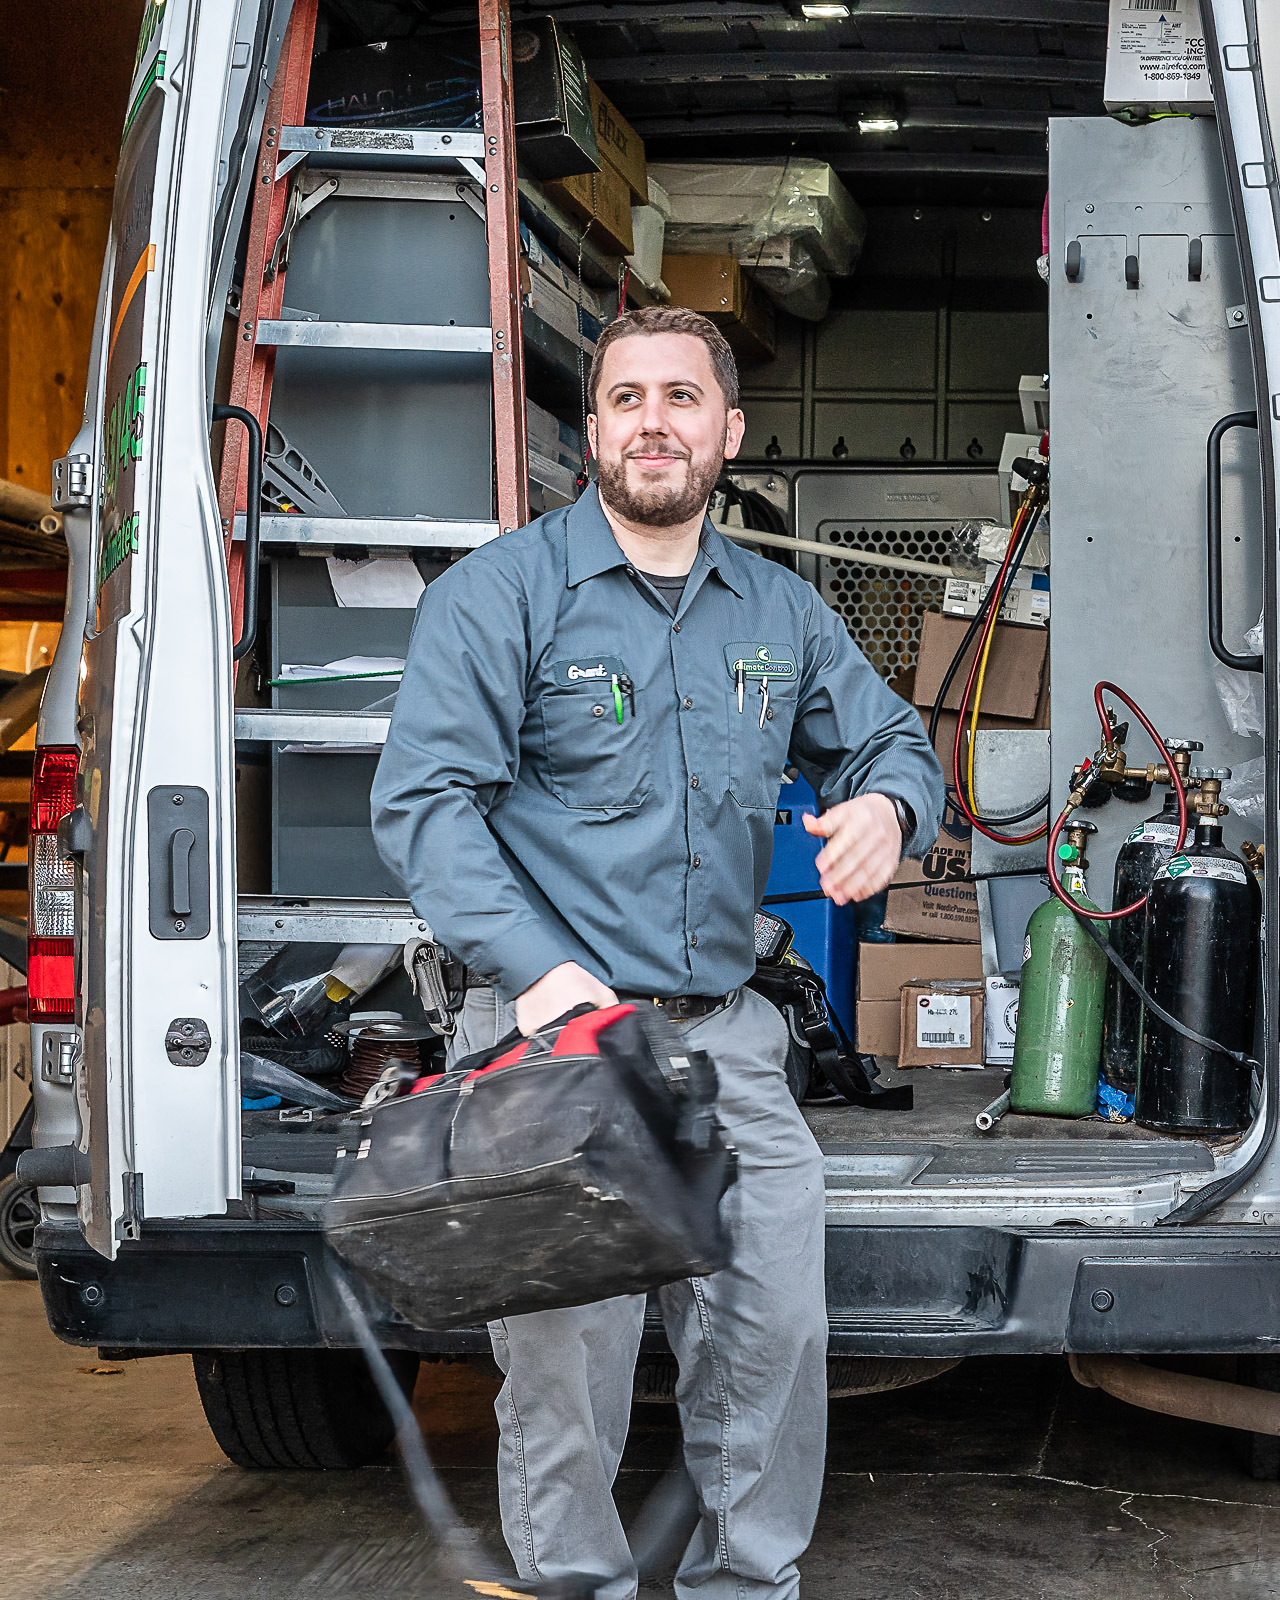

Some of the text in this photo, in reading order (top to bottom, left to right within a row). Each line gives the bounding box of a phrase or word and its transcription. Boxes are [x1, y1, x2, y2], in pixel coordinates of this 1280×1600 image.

[1139, 62, 1206, 71] www.airefco.com
[954, 850, 965, 858] IN
[923, 883, 977, 901] Questions
[922, 900, 935, 910] Visit
[929, 911, 939, 919] call
